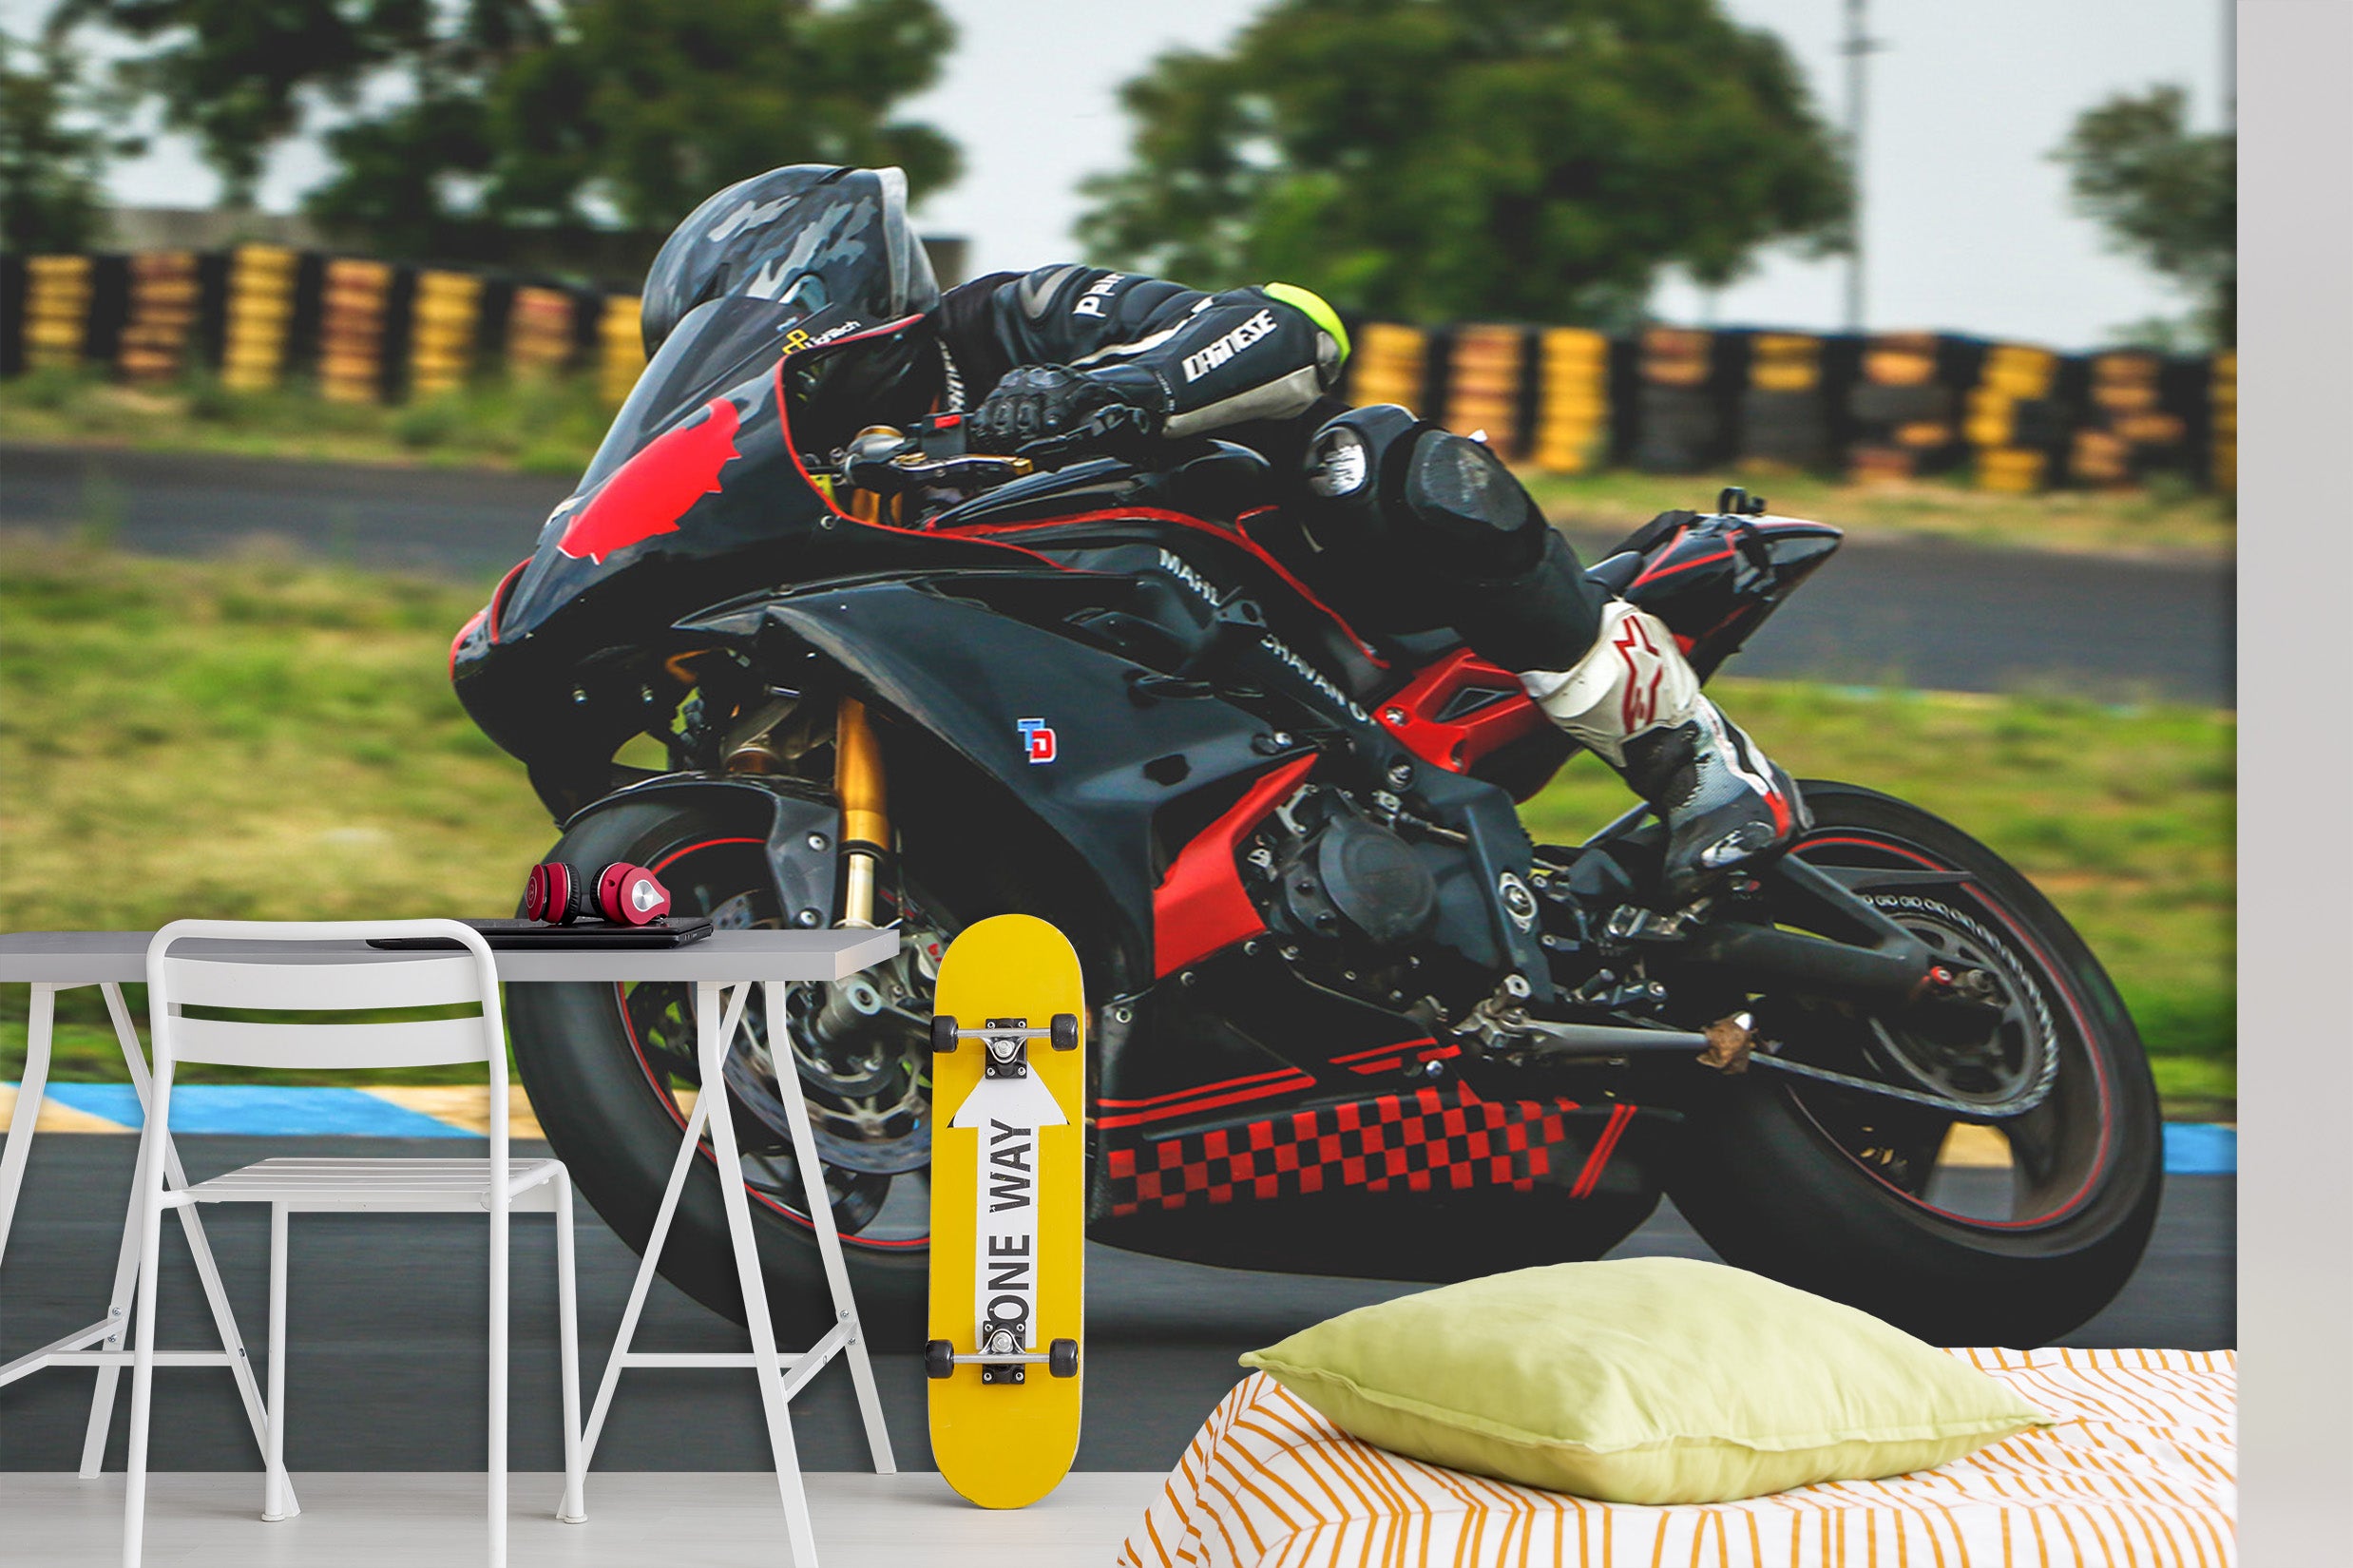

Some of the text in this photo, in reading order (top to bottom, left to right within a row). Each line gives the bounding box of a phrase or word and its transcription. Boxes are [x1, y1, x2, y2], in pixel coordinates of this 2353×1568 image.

[1182, 309, 1278, 384] DAINESE
[986, 1118, 1032, 1323] ONE WAY
